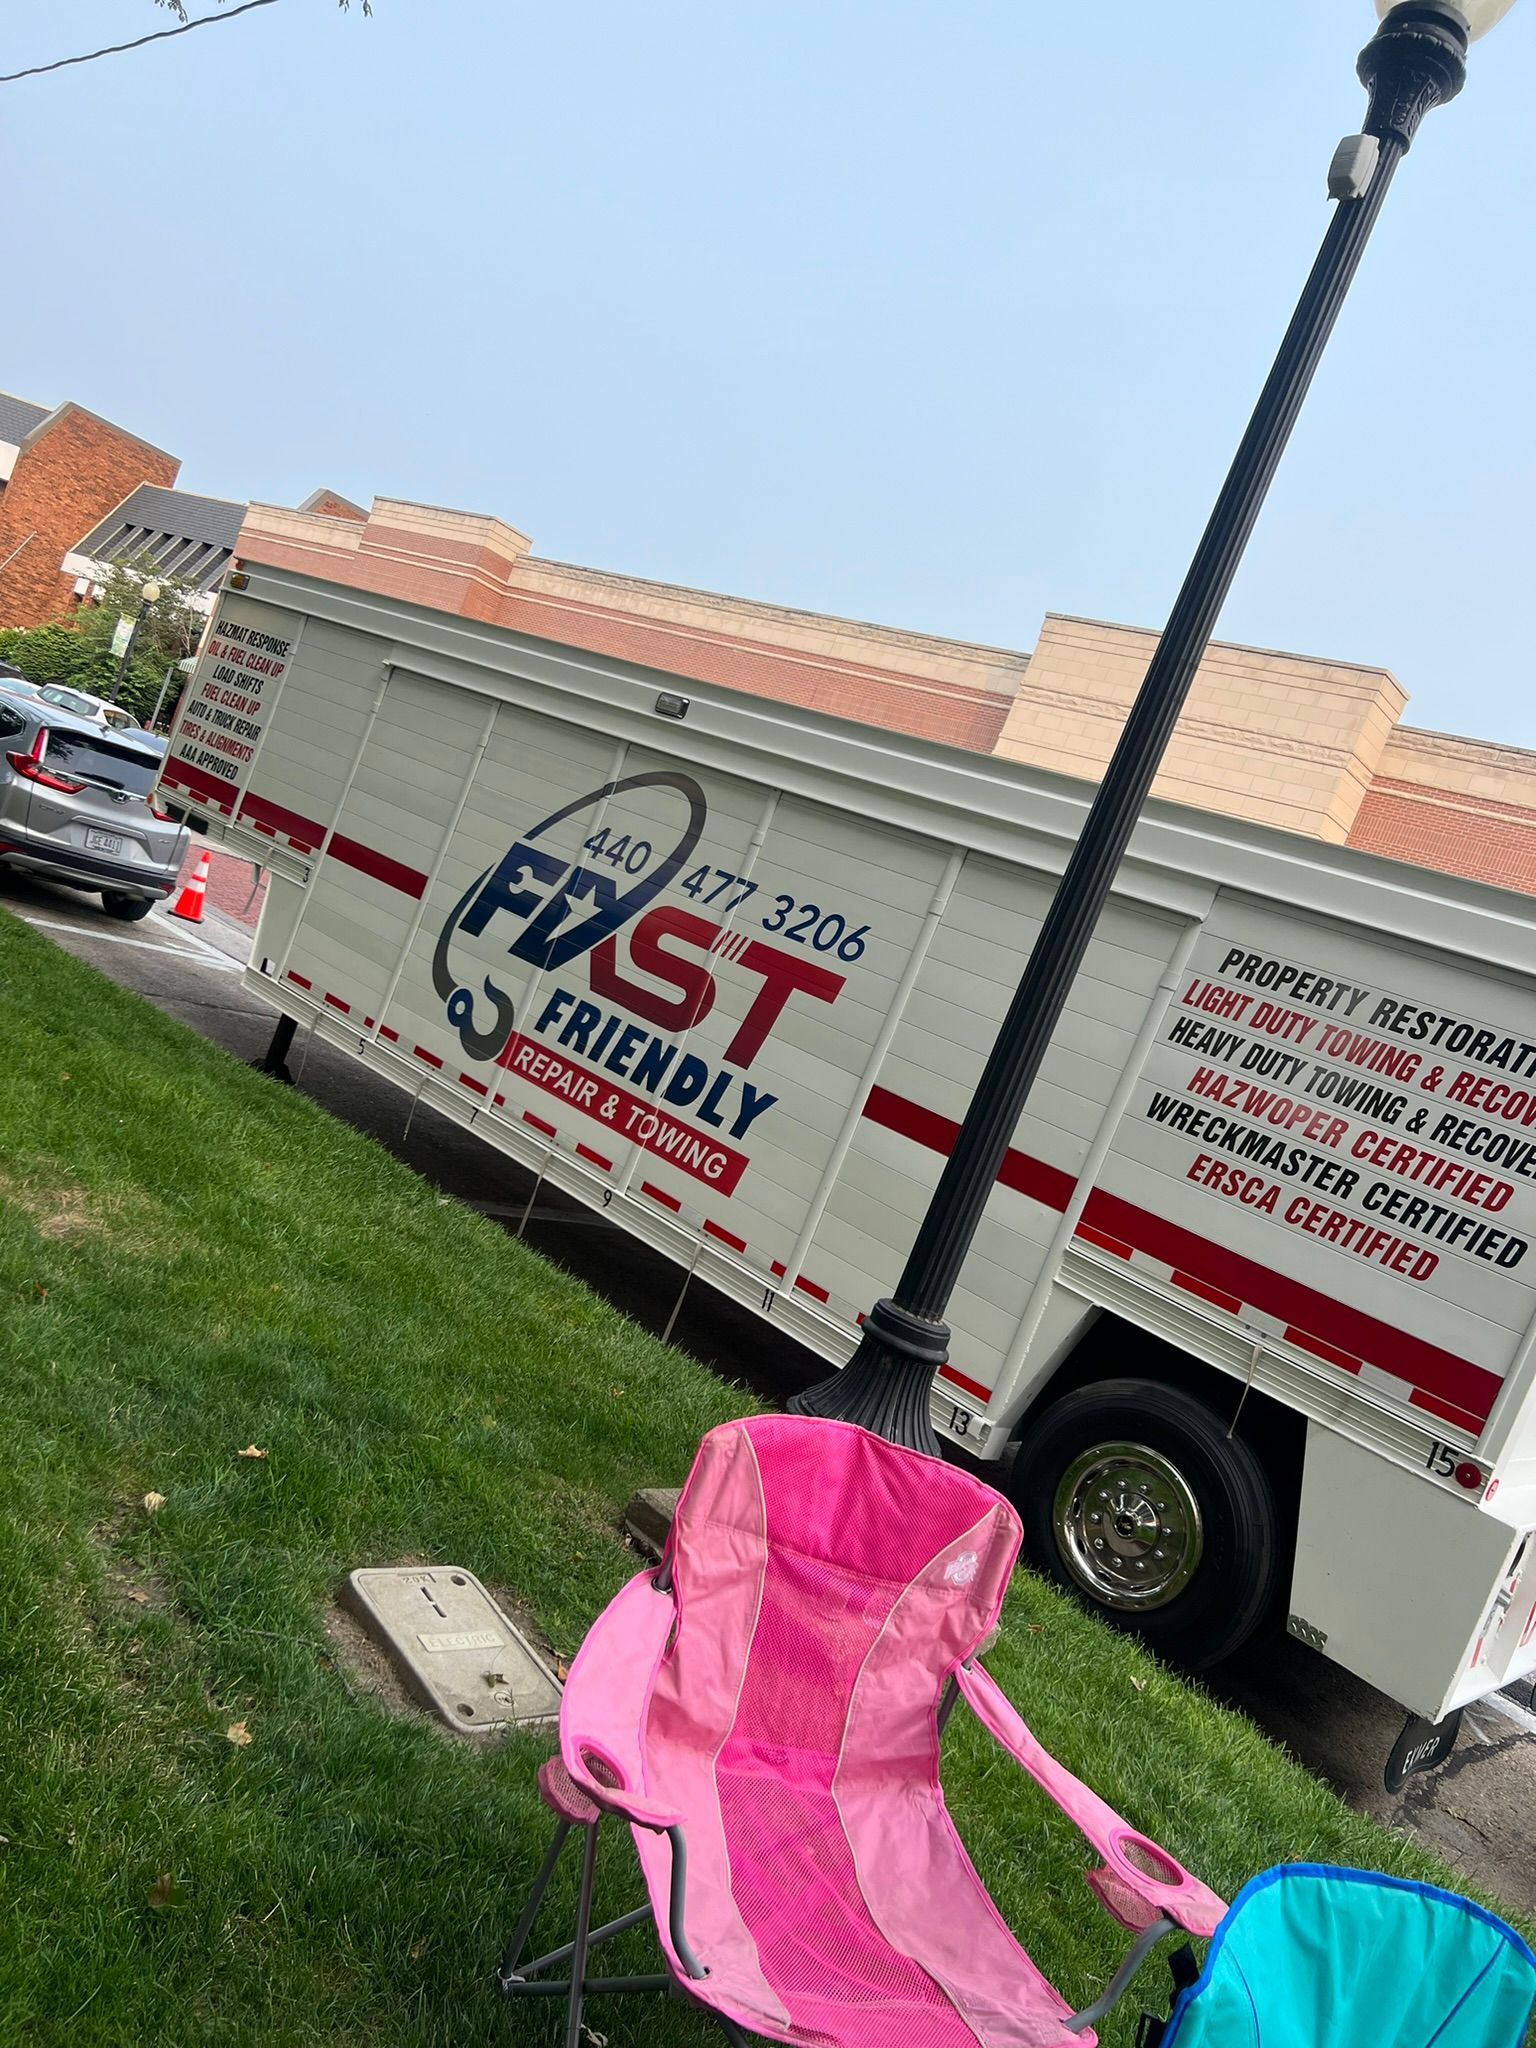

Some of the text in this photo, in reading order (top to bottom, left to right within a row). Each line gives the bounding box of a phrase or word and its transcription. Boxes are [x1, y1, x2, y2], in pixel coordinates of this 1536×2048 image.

[215, 620, 291, 657] HAZMAT RESPONSE
[208, 640, 285, 678] OIL & FUEL CLEAN UP
[212, 664, 264, 695] LOAD SHIFTS
[201, 682, 261, 716] FUEL CLEAN UP
[187, 699, 262, 742] AUTO & TRUCK REPAIR
[179, 719, 254, 763] TIRES & ALIGNMENTS
[179, 743, 239, 780] AAA APPROVED
[584, 827, 871, 962] 440 477 3206
[1217, 948, 1370, 1017] PROPERTY
[358, 1038, 366, 1055] 5
[533, 988, 779, 1140] FRIENDLY
[1182, 978, 1536, 1129] LIGHT DUTY TOWING & RECOV
[470, 1107, 480, 1124] 7
[513, 1046, 729, 1180] REPAIR & TOWING
[1168, 1016, 1536, 1179] HEAVY DUTY TOWING & RECOVE
[1186, 1066, 1515, 1212] HAZWOPER CERTIFIED
[603, 1189, 612, 1207] 9
[1146, 1091, 1529, 1269] WRECKMASTER CERTIFIED
[1186, 1153, 1440, 1281] ERSCA CERTIFIED
[762, 1288, 774, 1312] 11
[948, 1406, 970, 1436] 13
[1425, 1441, 1459, 1478] 15
[429, 1634, 496, 1648] ELECTRIC
